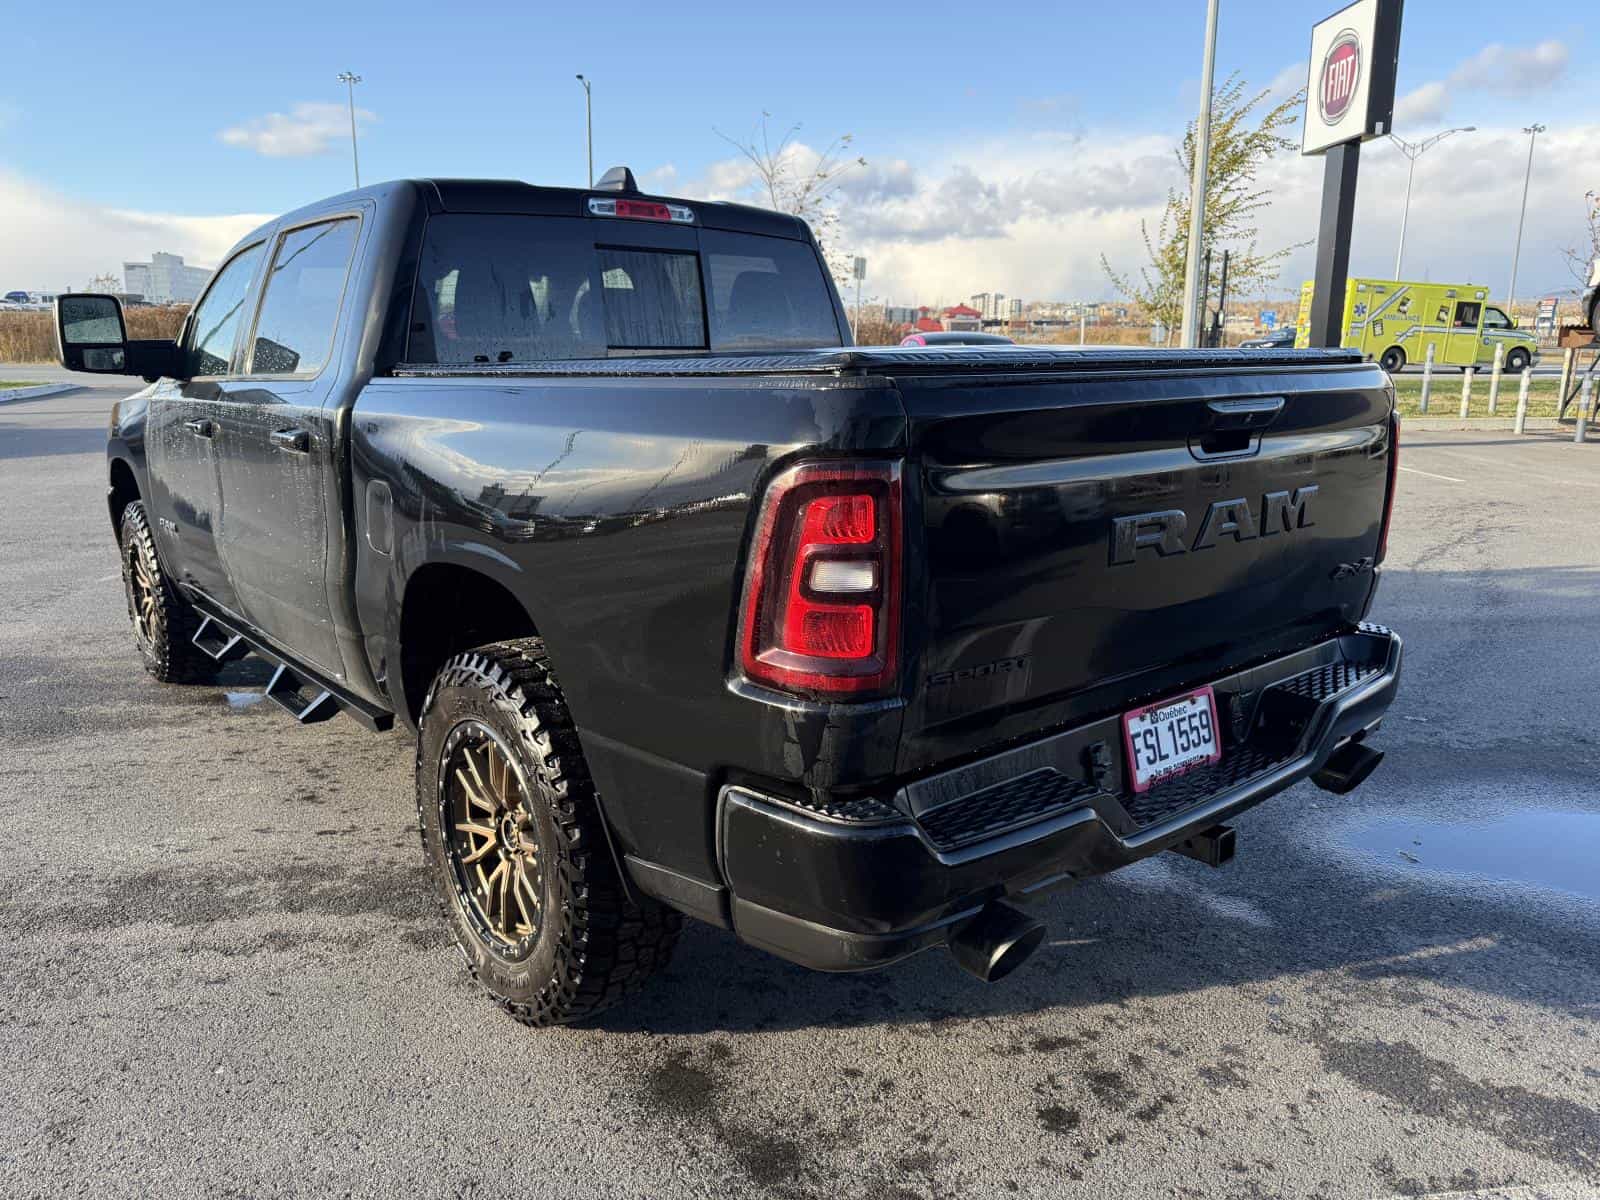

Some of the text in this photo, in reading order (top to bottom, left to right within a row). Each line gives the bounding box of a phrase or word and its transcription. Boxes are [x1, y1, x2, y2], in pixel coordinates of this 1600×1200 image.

[1326, 54, 1355, 104] FIAT
[1108, 484, 1320, 567] RAM
[926, 653, 1032, 687] SPORT
[1158, 705, 1187, 721] Québec
[1131, 709, 1213, 770] FSL 1559
